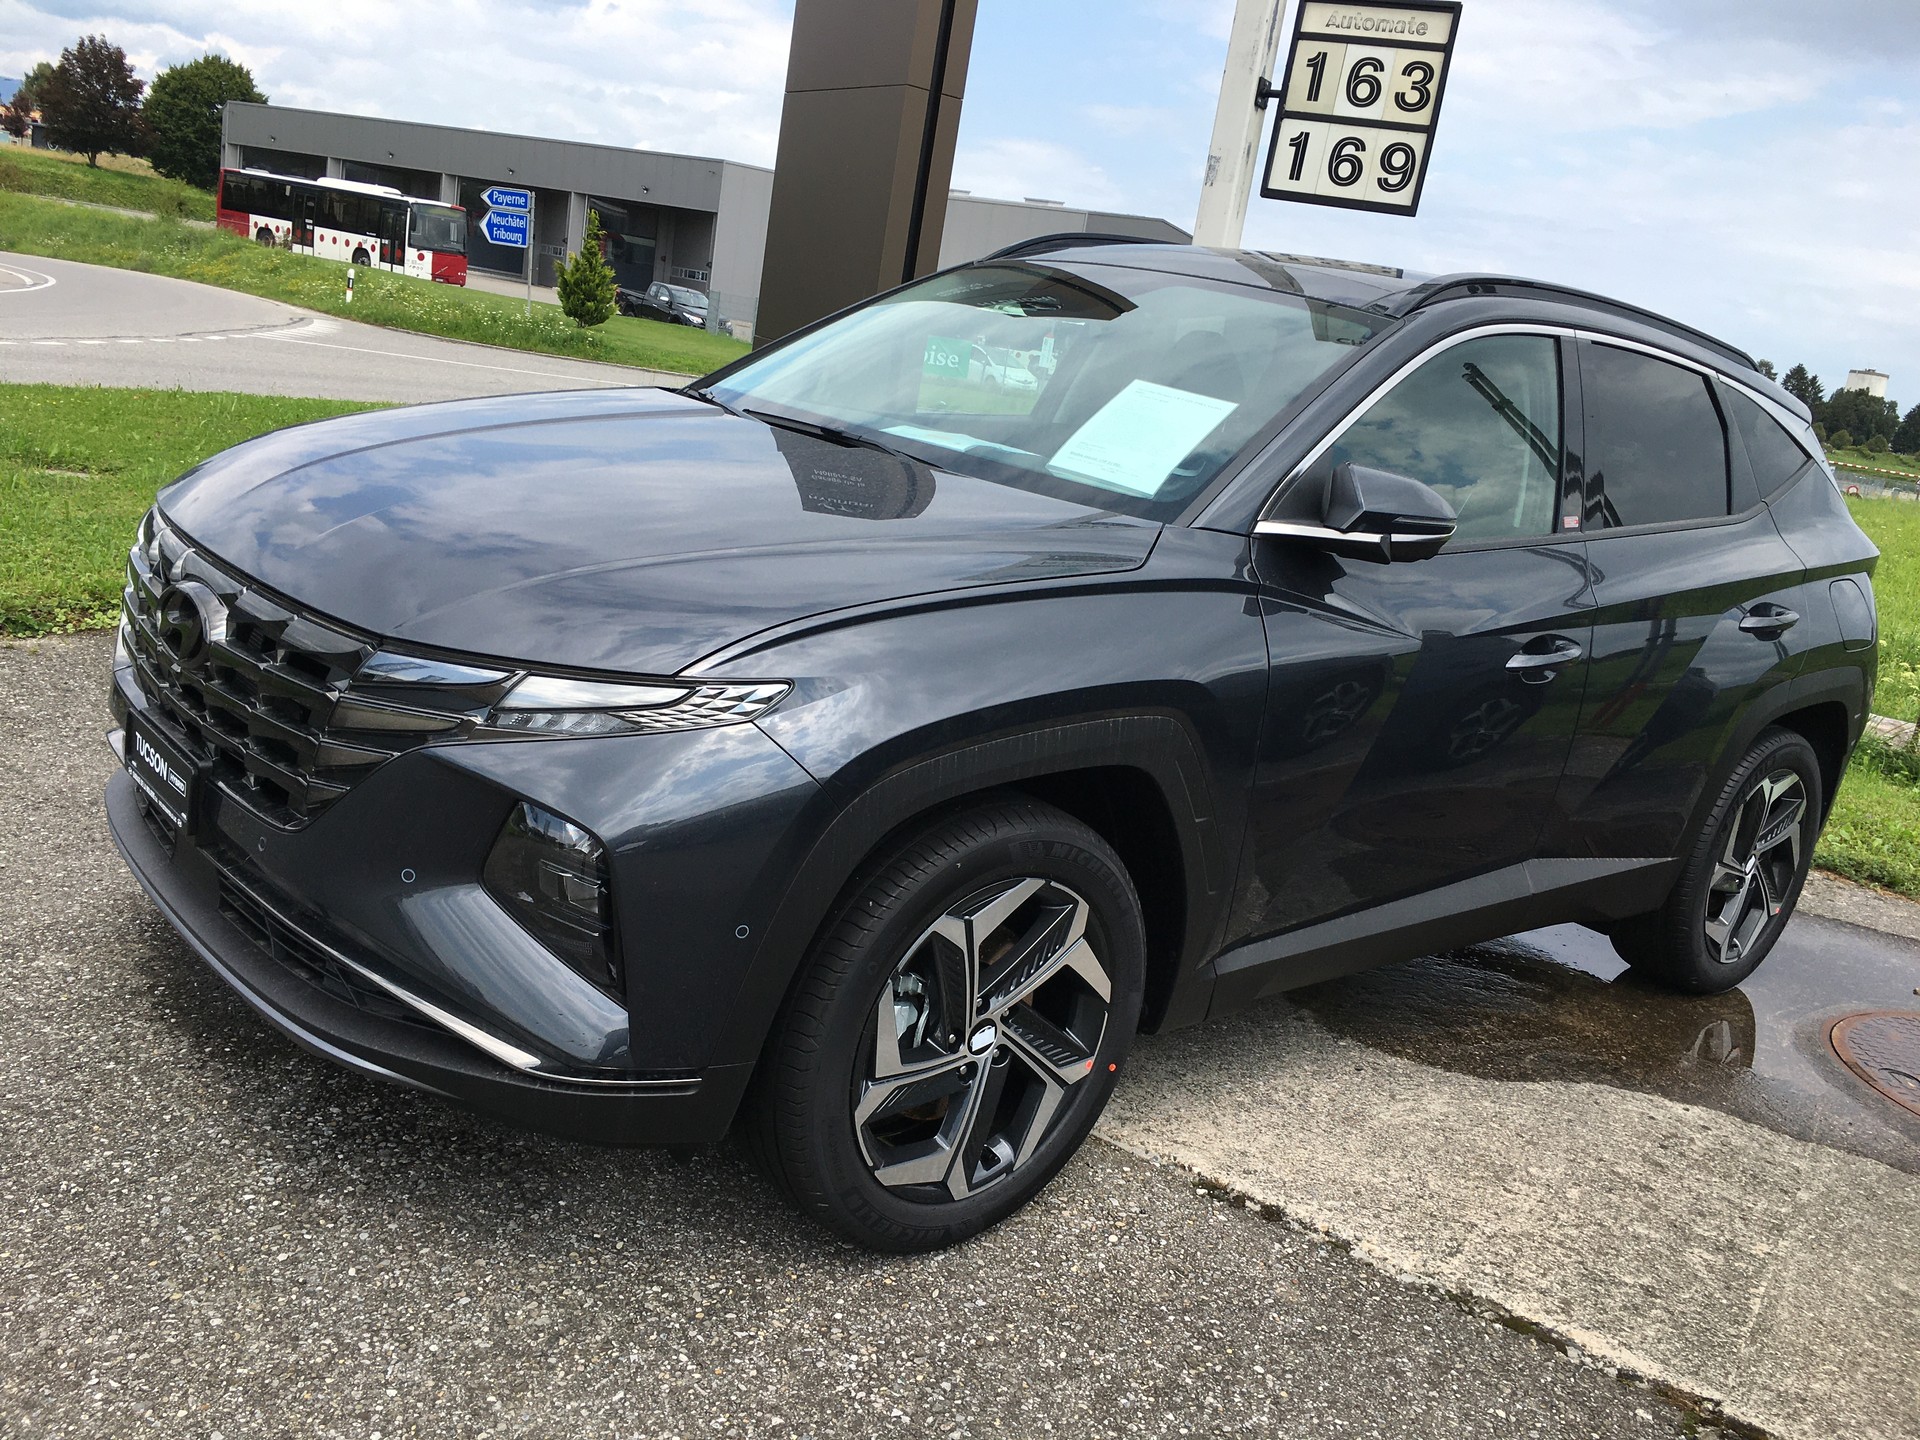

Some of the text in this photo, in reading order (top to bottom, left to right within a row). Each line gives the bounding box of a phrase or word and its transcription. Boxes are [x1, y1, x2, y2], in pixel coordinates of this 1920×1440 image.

[1325, 10, 1429, 36] Automate
[1305, 51, 1435, 113] 163
[1288, 131, 1417, 193] 169
[492, 190, 526, 206] Payerne
[490, 213, 527, 229] Neuchâtel
[493, 227, 523, 245] Fribourg
[135, 731, 168, 781] TUCSON
